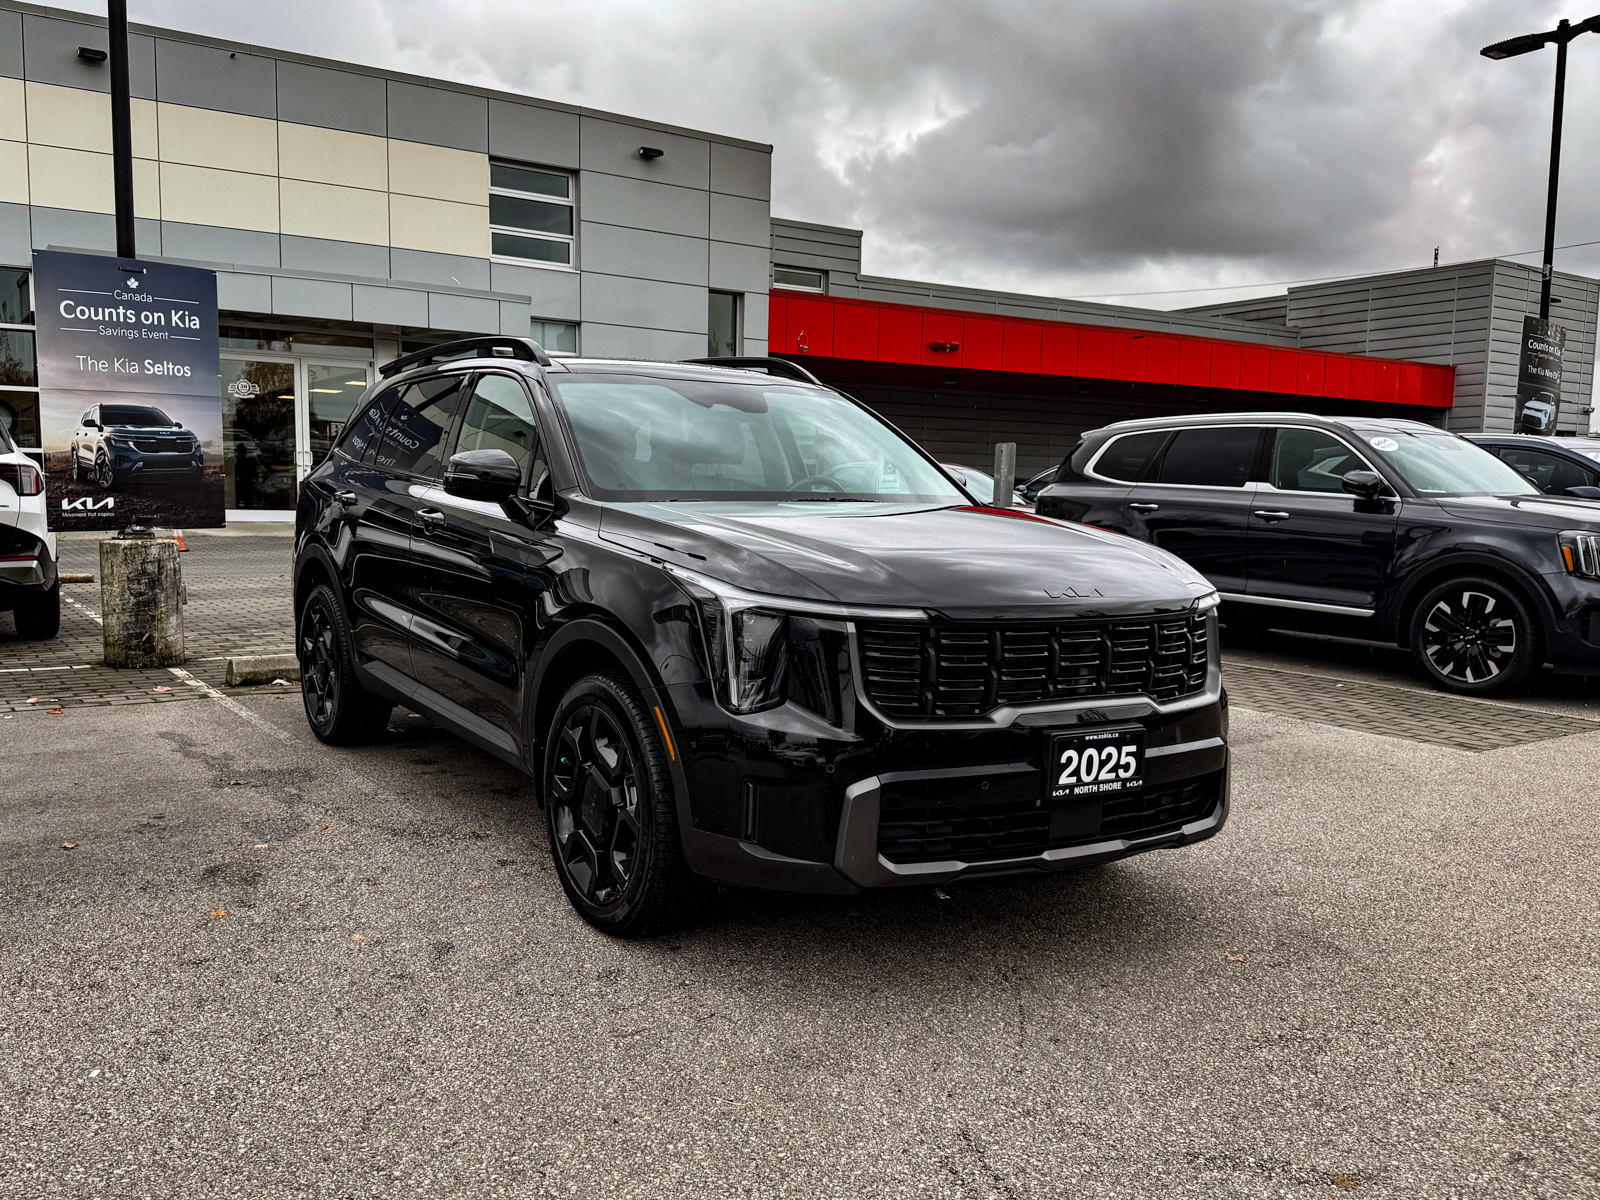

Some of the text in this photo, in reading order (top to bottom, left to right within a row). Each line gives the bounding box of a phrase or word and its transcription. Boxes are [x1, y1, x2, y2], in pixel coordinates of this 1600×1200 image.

[114, 290, 152, 303] Canada
[59, 300, 200, 330] Counts on Kia
[99, 326, 168, 340] Savings Event
[1528, 339, 1549, 352] Counts
[76, 355, 191, 377] The Kia Seltos
[1528, 365, 1537, 374] The
[62, 497, 115, 510] KIA
[1043, 586, 1104, 598] KIA
[1085, 732, 1119, 740] www.nskia.ca
[1058, 745, 1137, 784] 2025
[1052, 788, 1069, 796] KIA
[1074, 784, 1098, 795] NORTH
[1099, 782, 1122, 792] SHORE
